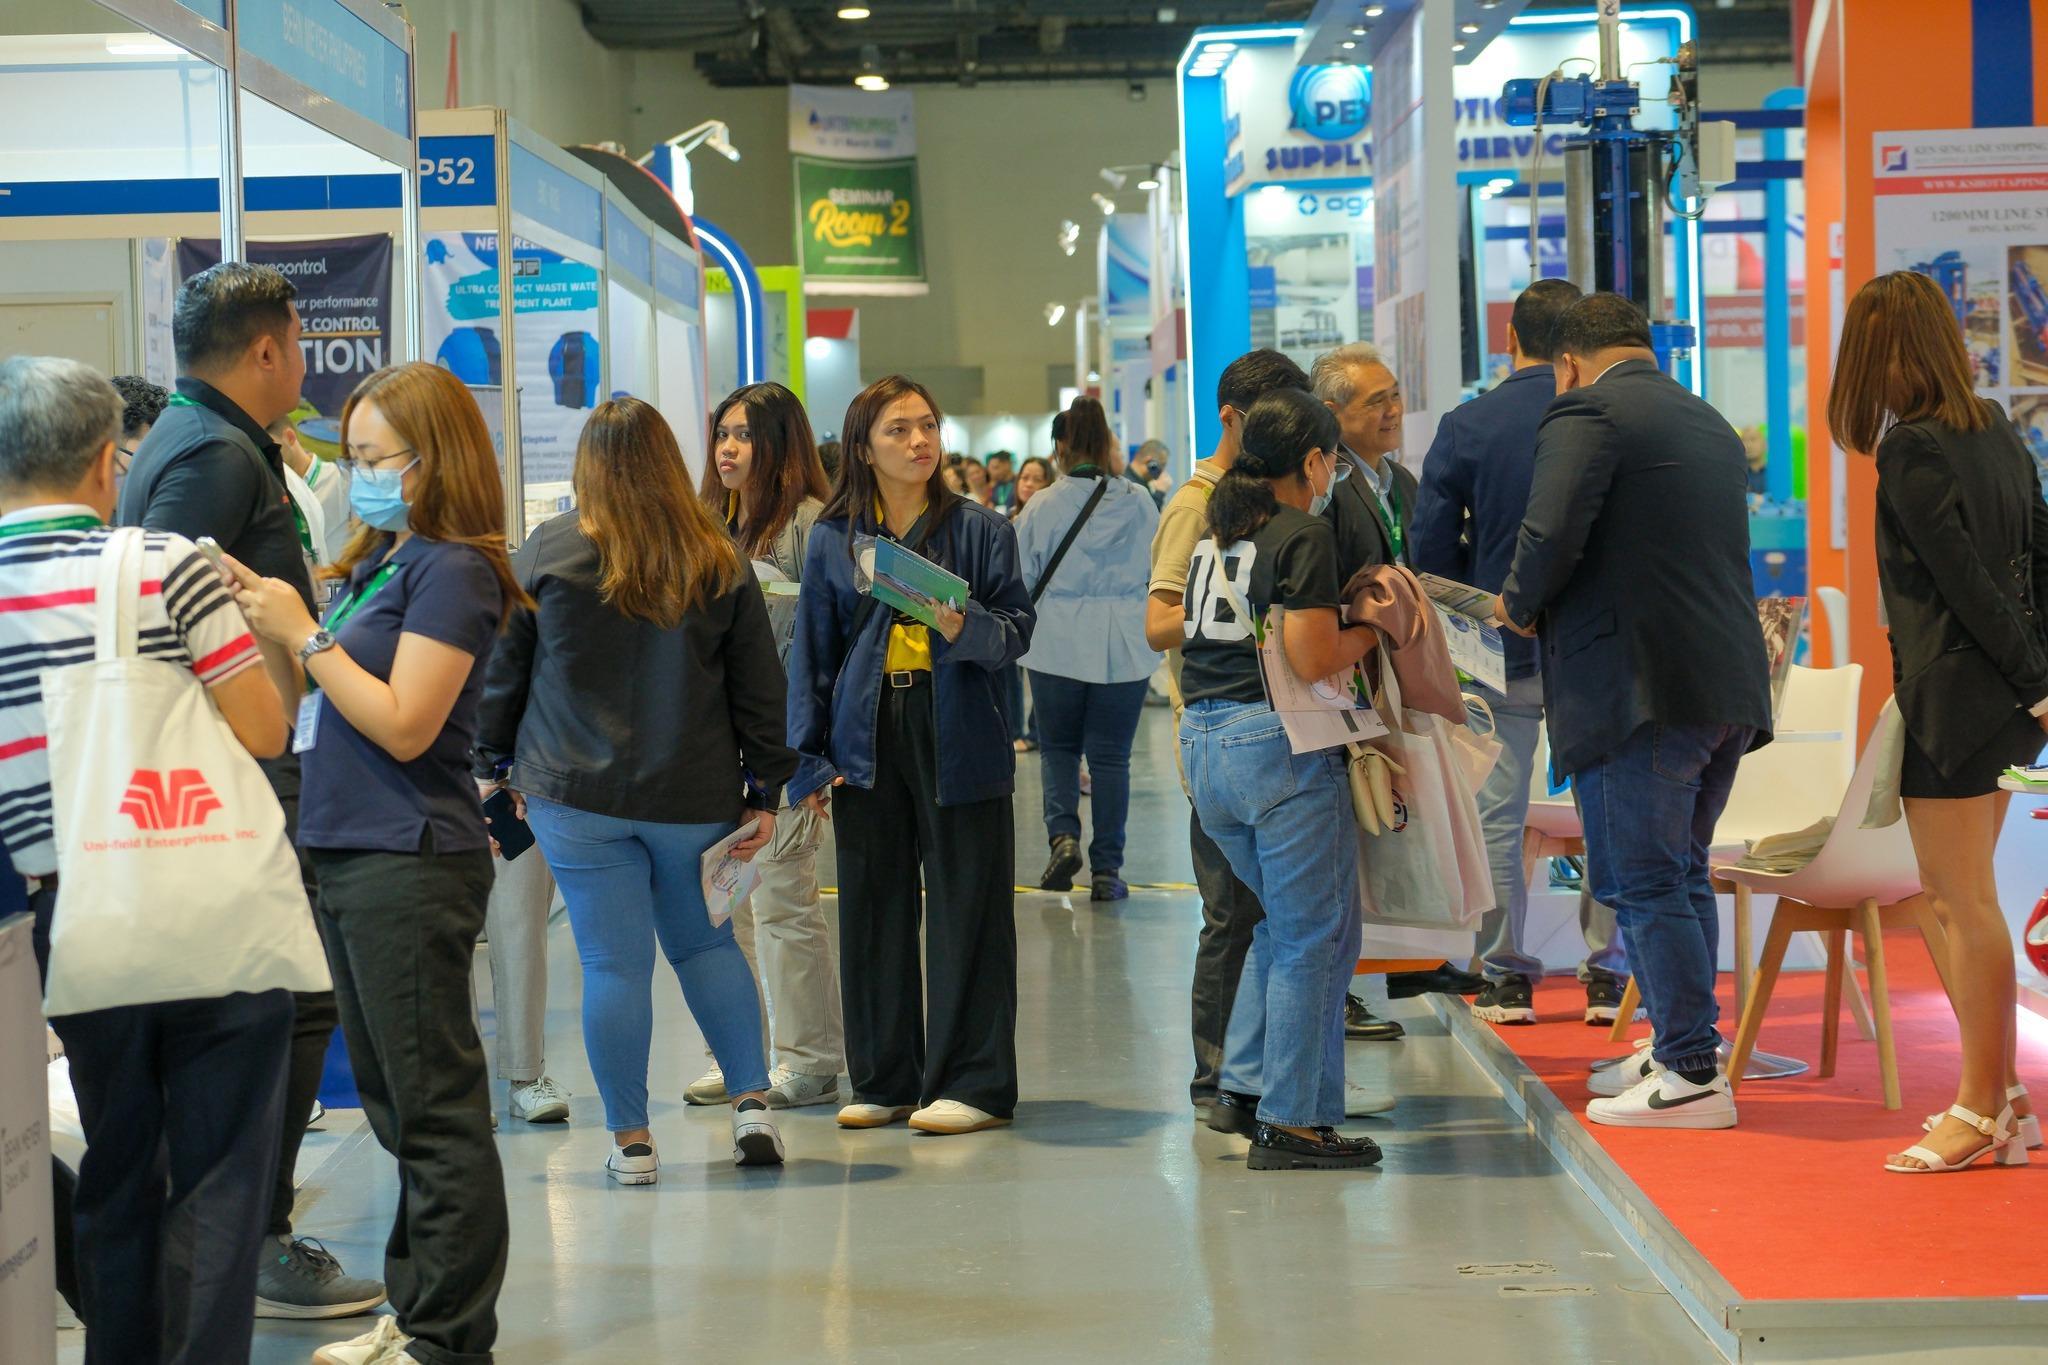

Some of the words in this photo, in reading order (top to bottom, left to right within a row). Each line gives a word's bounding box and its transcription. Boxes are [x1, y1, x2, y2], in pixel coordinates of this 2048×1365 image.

[417, 157, 475, 186] P52
[828, 187, 895, 206] SEMINAR
[808, 198, 885, 247] Room
[889, 199, 911, 237] 2
[475, 236, 499, 251] NE
[455, 282, 485, 294] ULTRA
[487, 282, 533, 295] COACT
[535, 281, 568, 294] WASTE
[570, 280, 598, 293] WATE
[309, 296, 379, 312] performance
[484, 298, 540, 309] TREMENT
[542, 297, 573, 308] PLANT
[311, 316, 380, 332] CONTROL
[298, 338, 382, 375] TION
[83, 837, 141, 852] Uni-field
